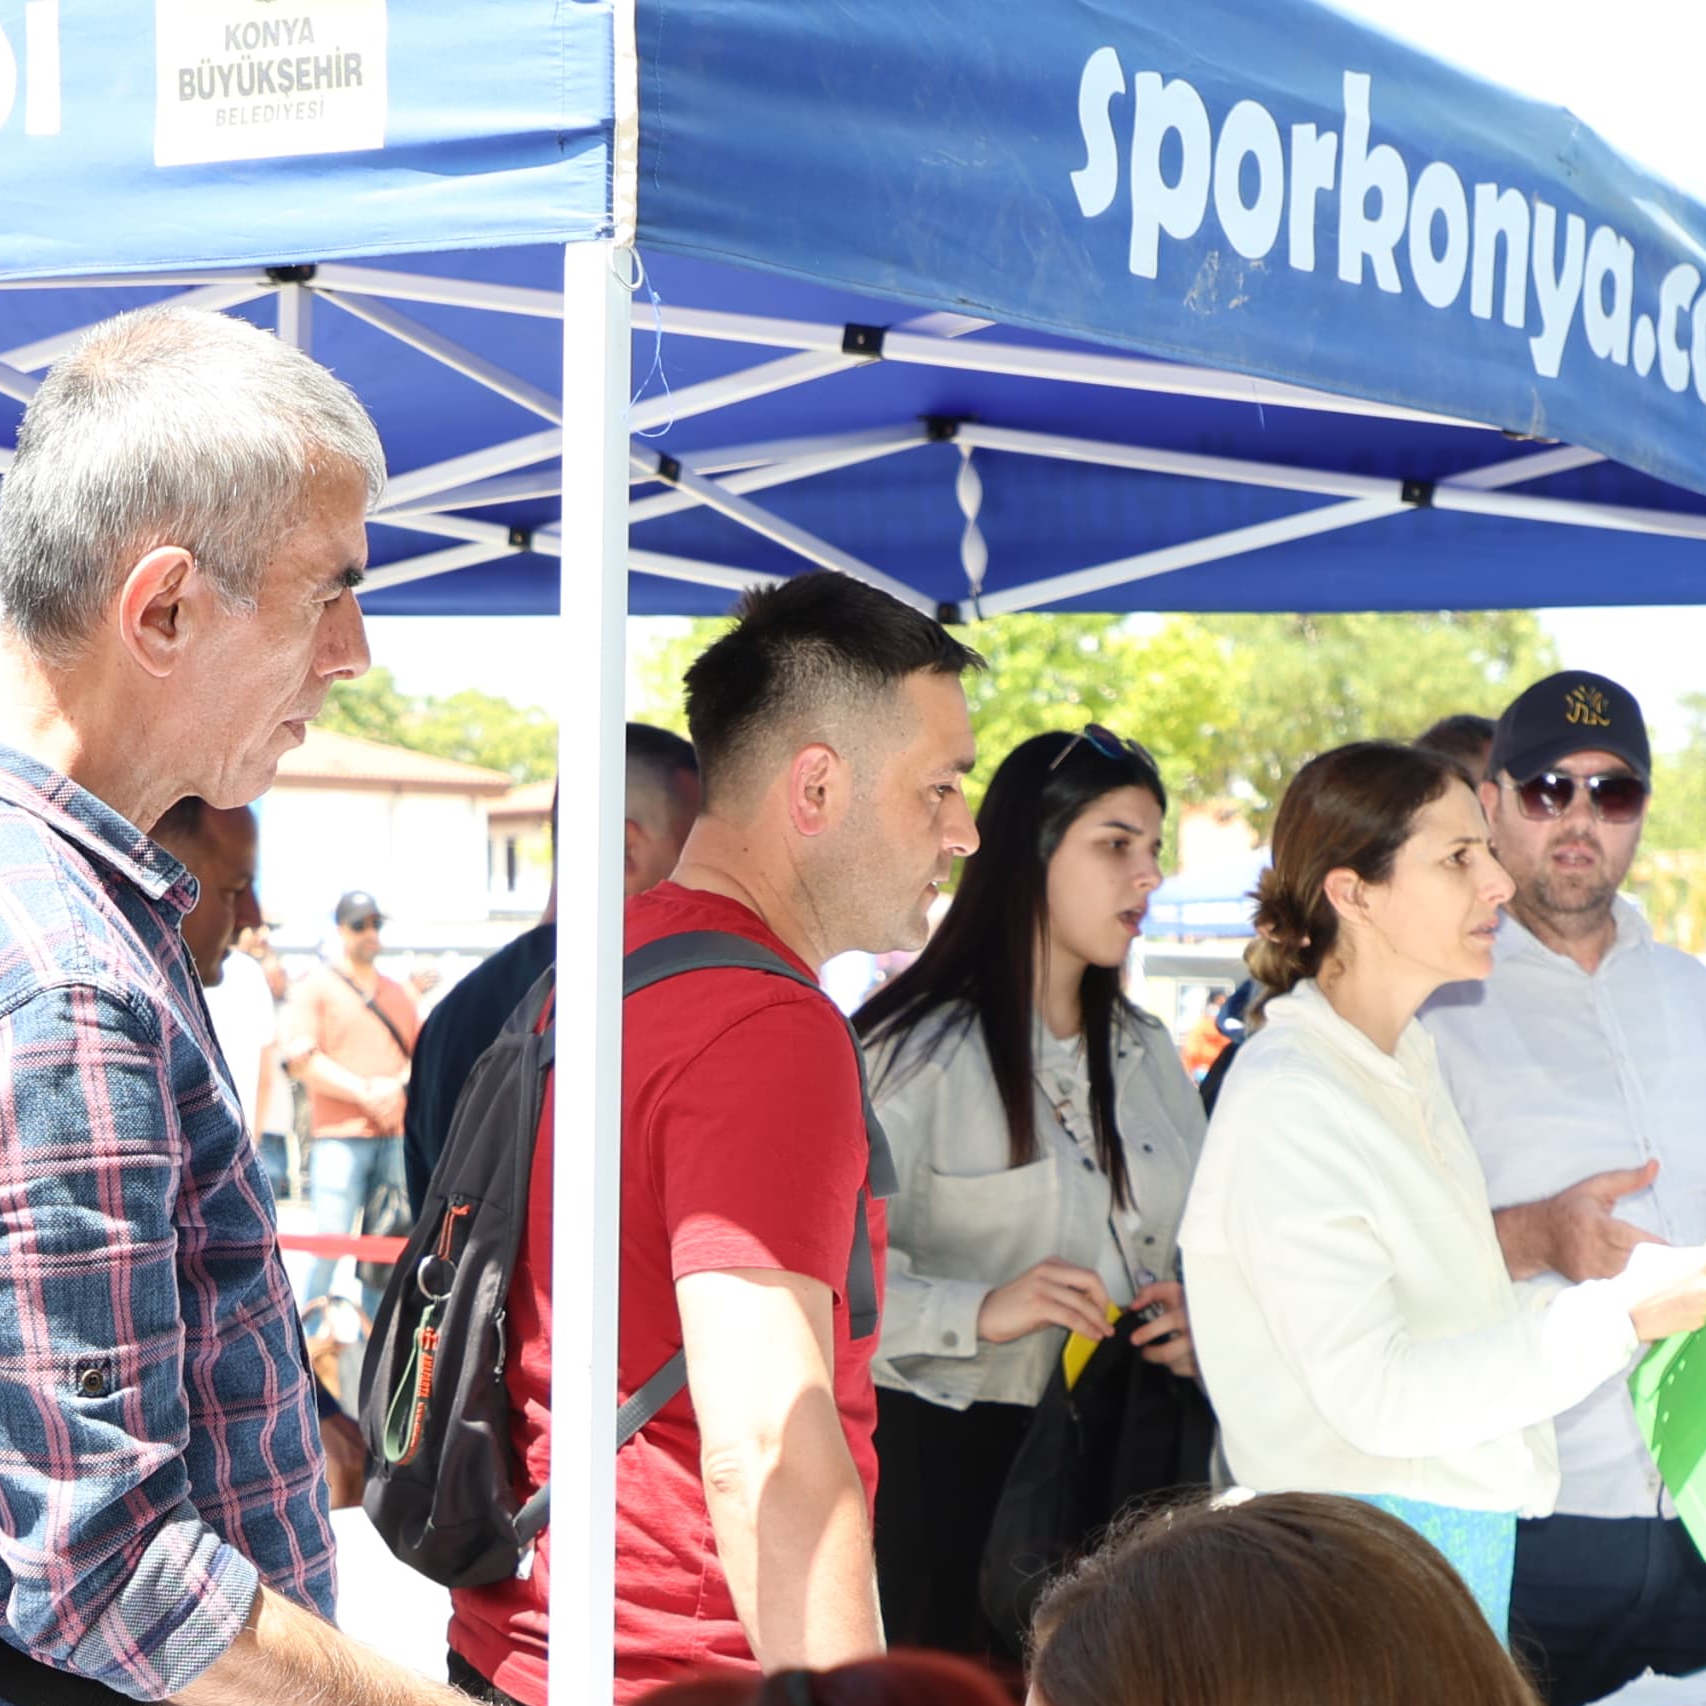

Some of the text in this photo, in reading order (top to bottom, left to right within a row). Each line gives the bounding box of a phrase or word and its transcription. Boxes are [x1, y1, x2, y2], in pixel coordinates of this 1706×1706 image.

[224, 16, 315, 52] KONYA
[178, 46, 363, 101] BÜYÜKŞEHİR
[215, 95, 325, 127] BELEDİYESİ
